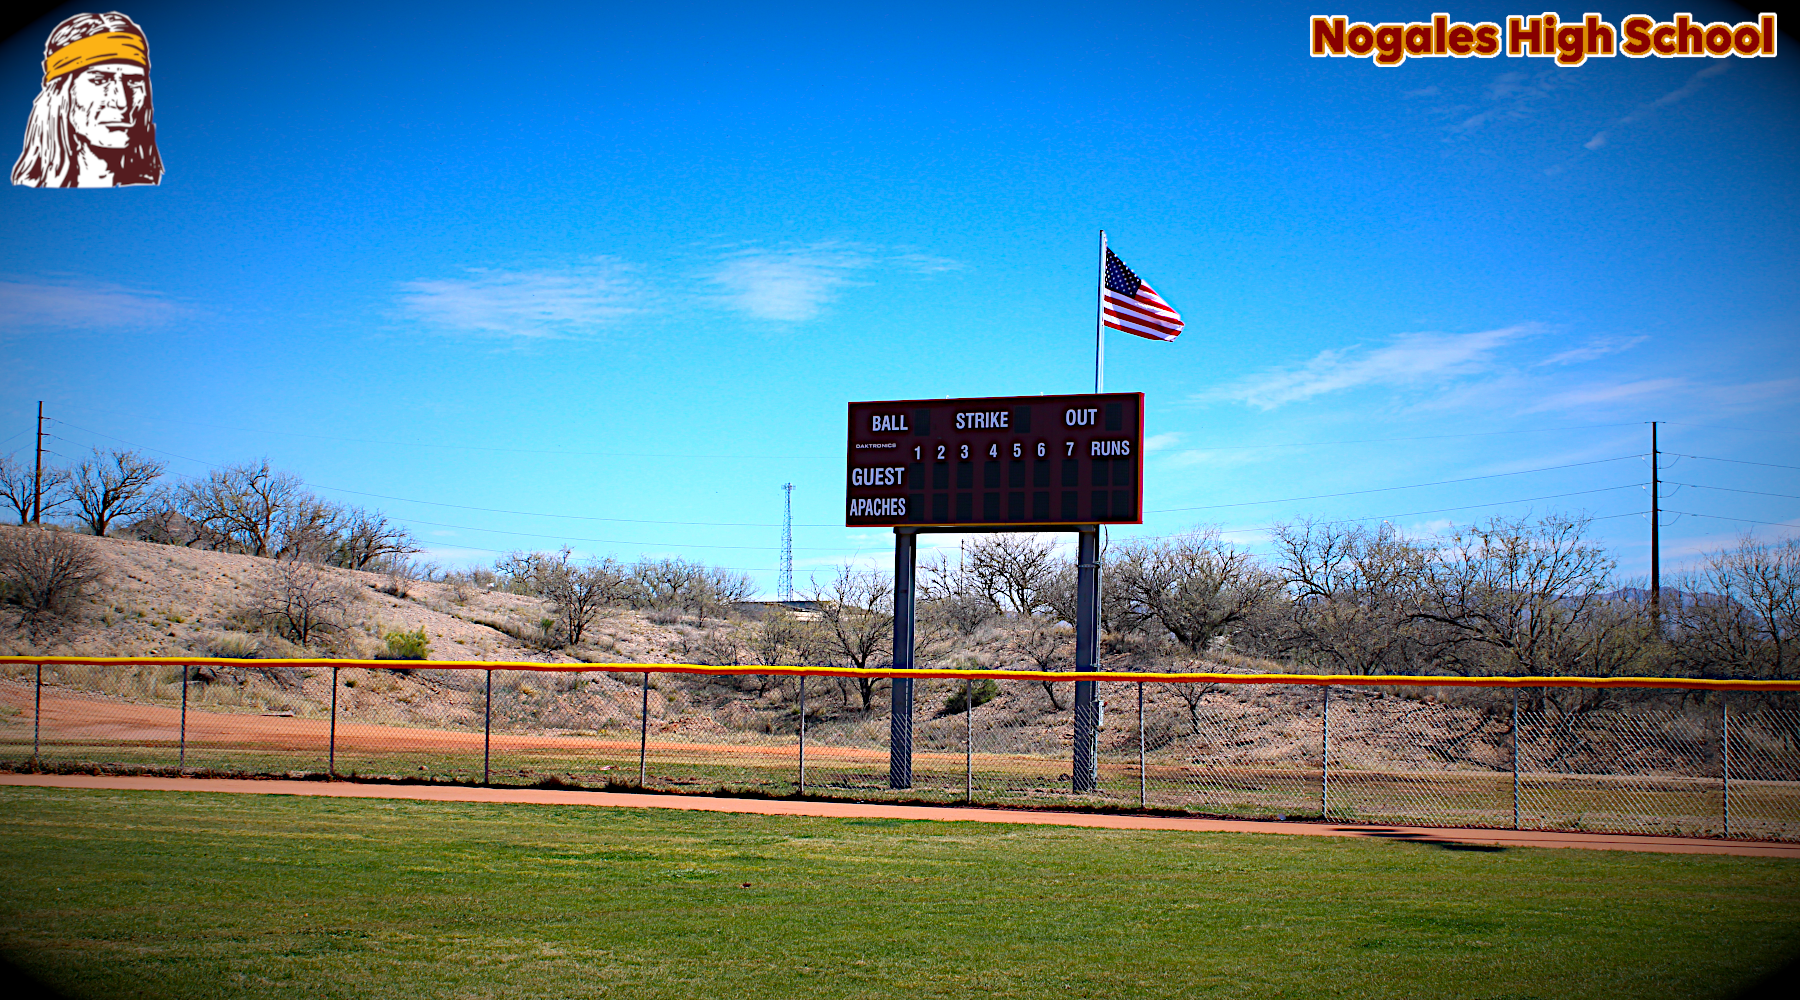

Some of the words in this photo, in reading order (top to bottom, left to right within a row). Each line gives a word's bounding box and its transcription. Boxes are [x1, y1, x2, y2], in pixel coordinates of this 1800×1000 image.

[873, 415, 908, 431] BALL
[956, 412, 1008, 428] STRIKE
[1066, 409, 1097, 425] OUT
[914, 445, 921, 460] 1
[938, 446, 945, 459] 2
[961, 445, 968, 458] 3
[990, 444, 997, 457] 4
[1014, 444, 1021, 457] 5
[1038, 443, 1045, 456] 6
[1067, 442, 1074, 455] 7
[1092, 441, 1129, 455] RUNS
[852, 467, 904, 485] GUEST
[850, 498, 905, 516] APACHES
